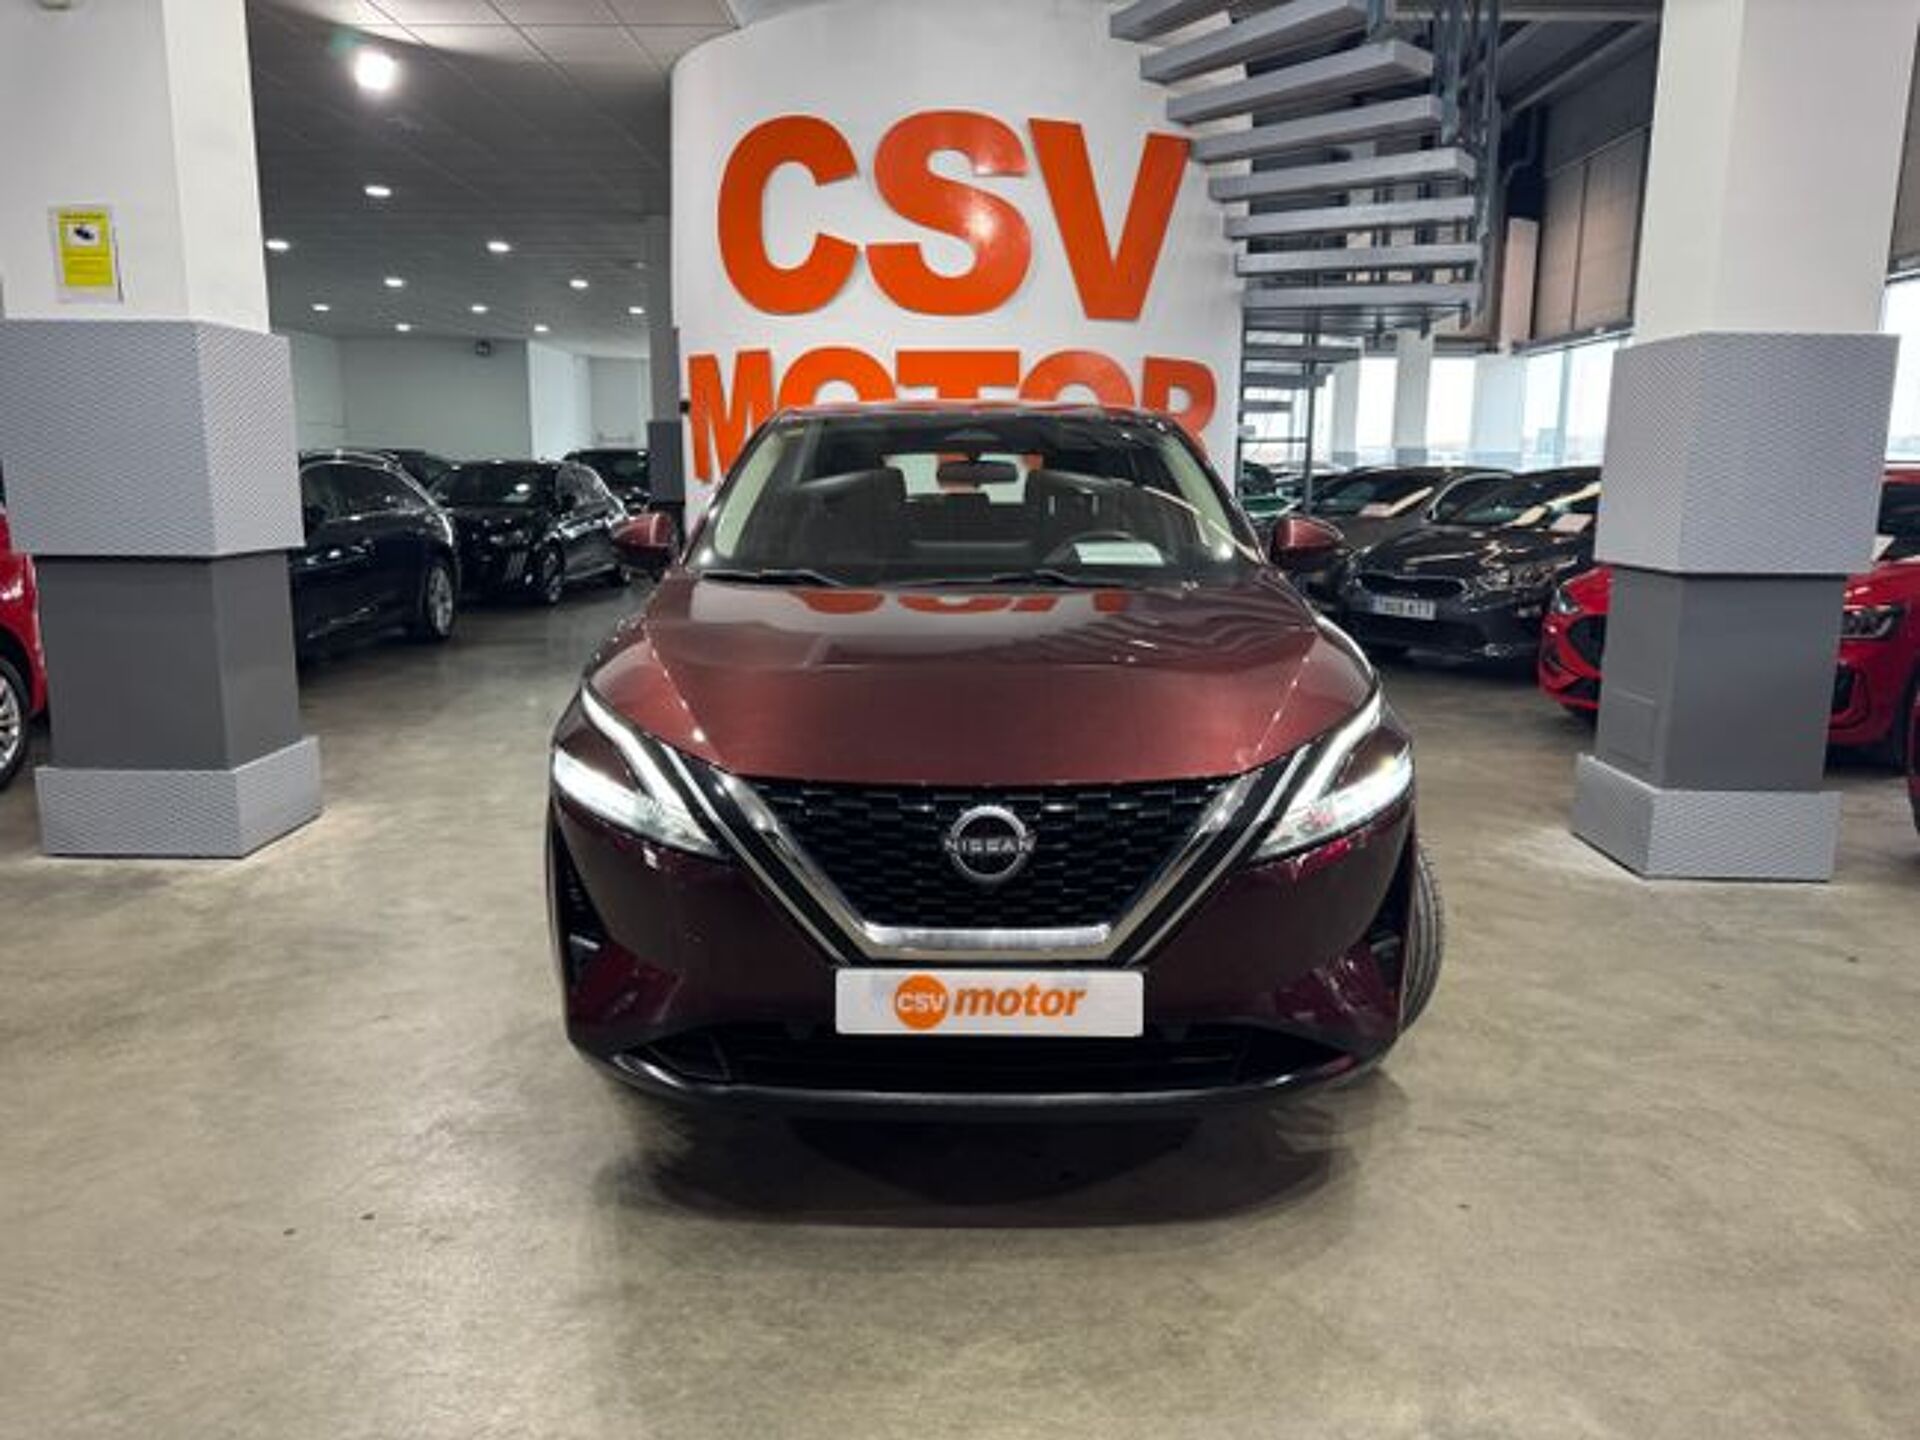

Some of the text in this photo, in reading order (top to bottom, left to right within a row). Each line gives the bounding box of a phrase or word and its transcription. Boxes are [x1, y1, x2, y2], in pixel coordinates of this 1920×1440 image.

[717, 110, 1191, 321] CSV
[944, 838, 1036, 852] NISSAN
[897, 984, 1086, 1016] CSV motor
